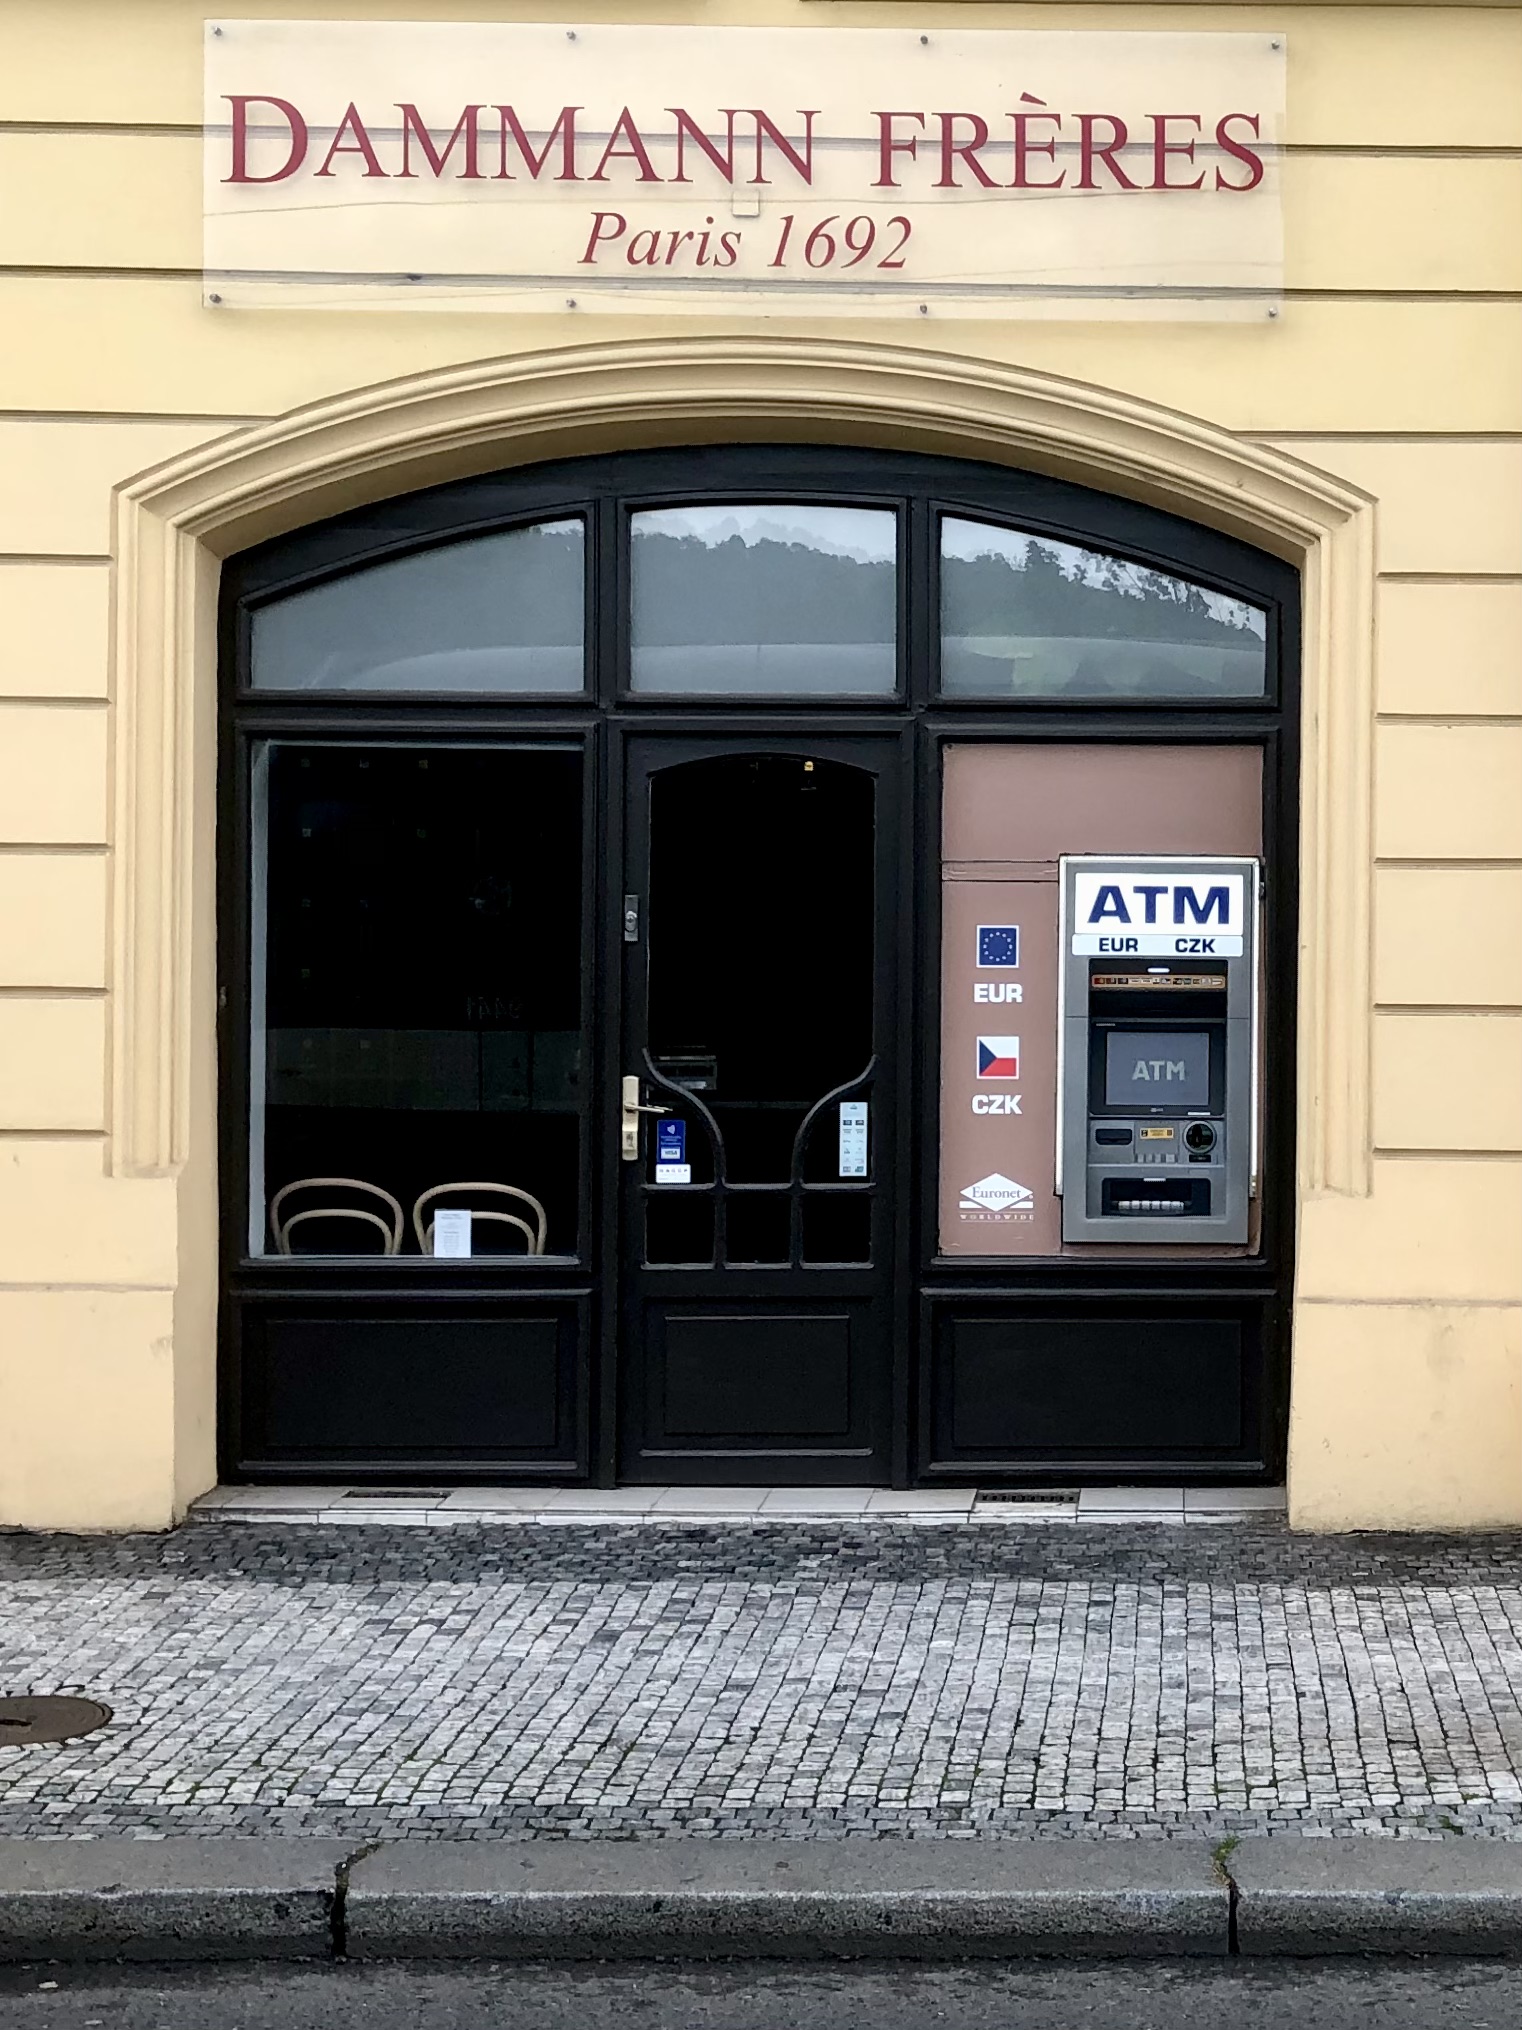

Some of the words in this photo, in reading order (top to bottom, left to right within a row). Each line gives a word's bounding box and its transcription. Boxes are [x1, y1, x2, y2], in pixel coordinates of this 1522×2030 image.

[221, 94, 822, 184] DAMMANN
[869, 91, 1264, 193] FRÈRES
[577, 212, 742, 266] Paris
[767, 214, 912, 269] 1692
[1088, 885, 1230, 925] ATM
[1098, 937, 1139, 953] EUR
[1174, 938, 1216, 954] CZK
[973, 983, 1023, 1003] EUR
[1132, 1060, 1185, 1081] ATM
[971, 1094, 1023, 1115] CZK
[972, 1186, 1022, 1199] Euronet
[959, 1213, 1035, 1222] WORLDWIDE
